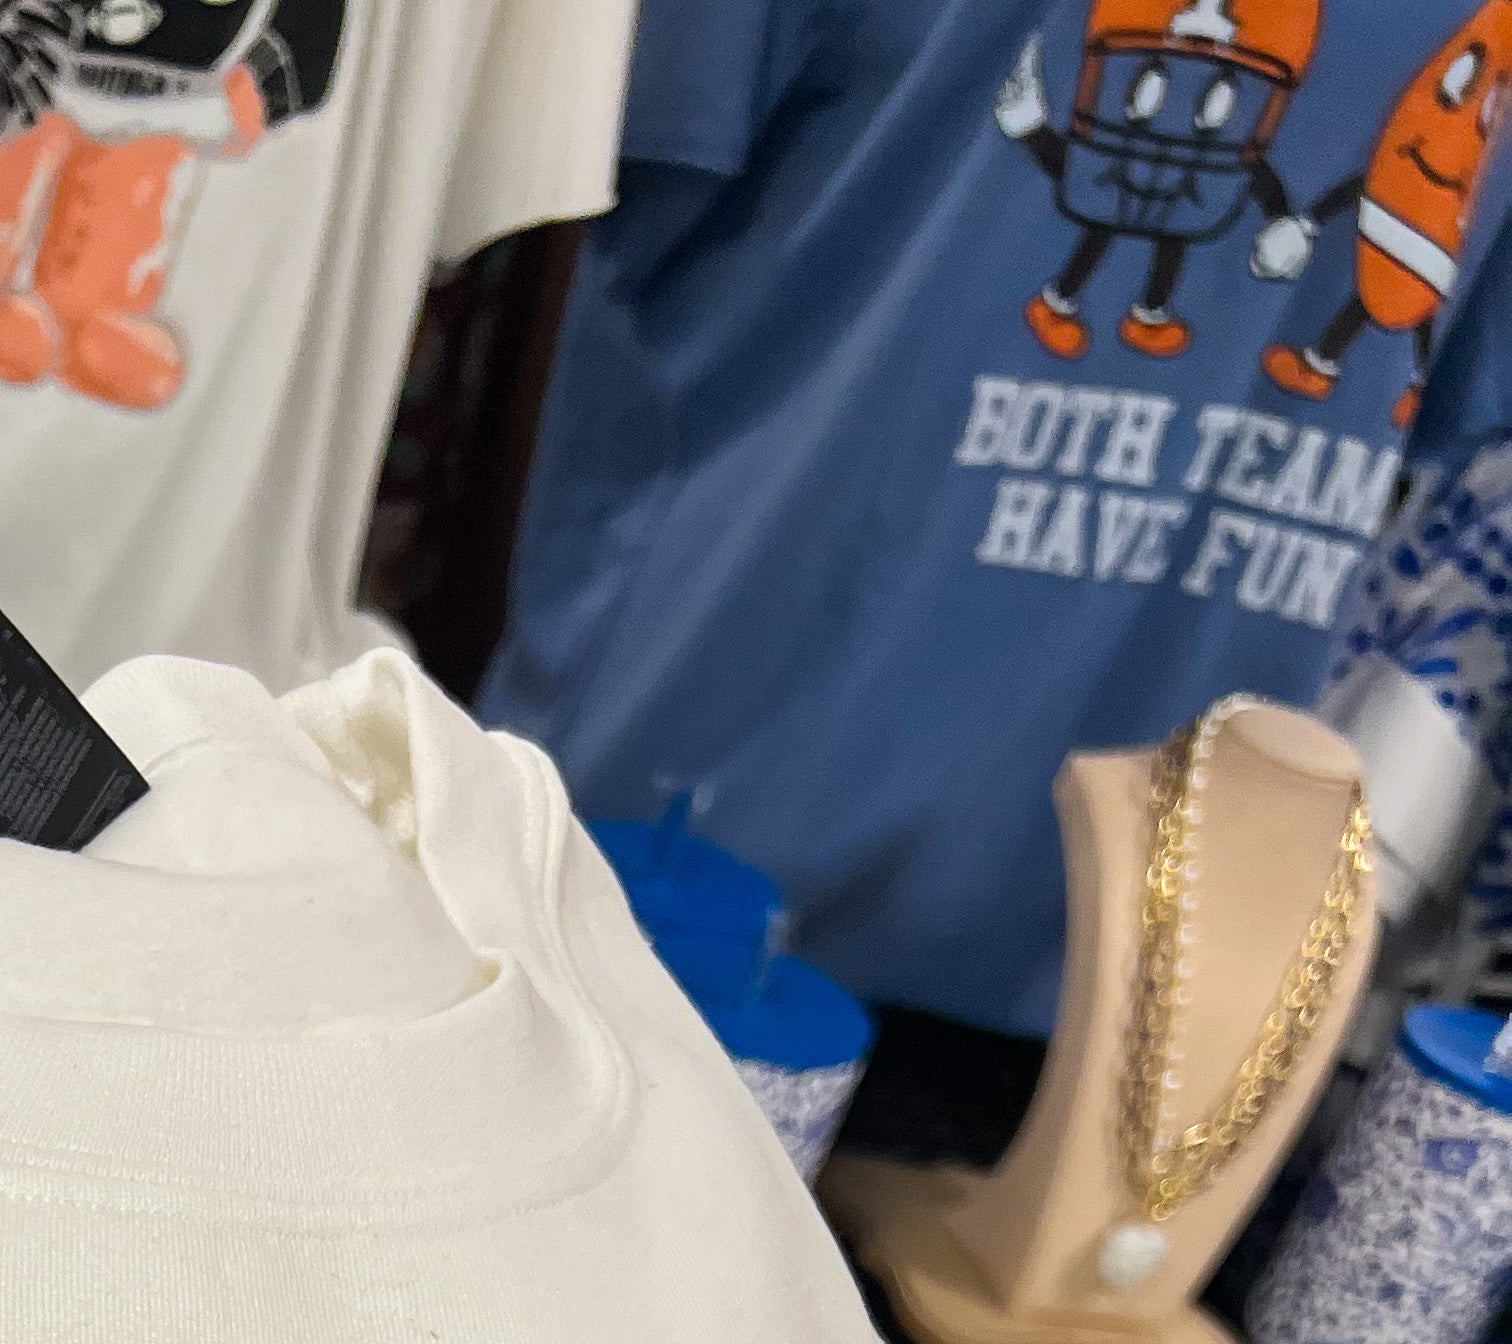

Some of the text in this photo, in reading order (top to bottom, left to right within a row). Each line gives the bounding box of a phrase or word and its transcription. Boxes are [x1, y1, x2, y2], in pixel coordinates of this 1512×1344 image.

[958, 377, 1176, 487] BOTH
[977, 478, 1361, 628] HAVE FUN
